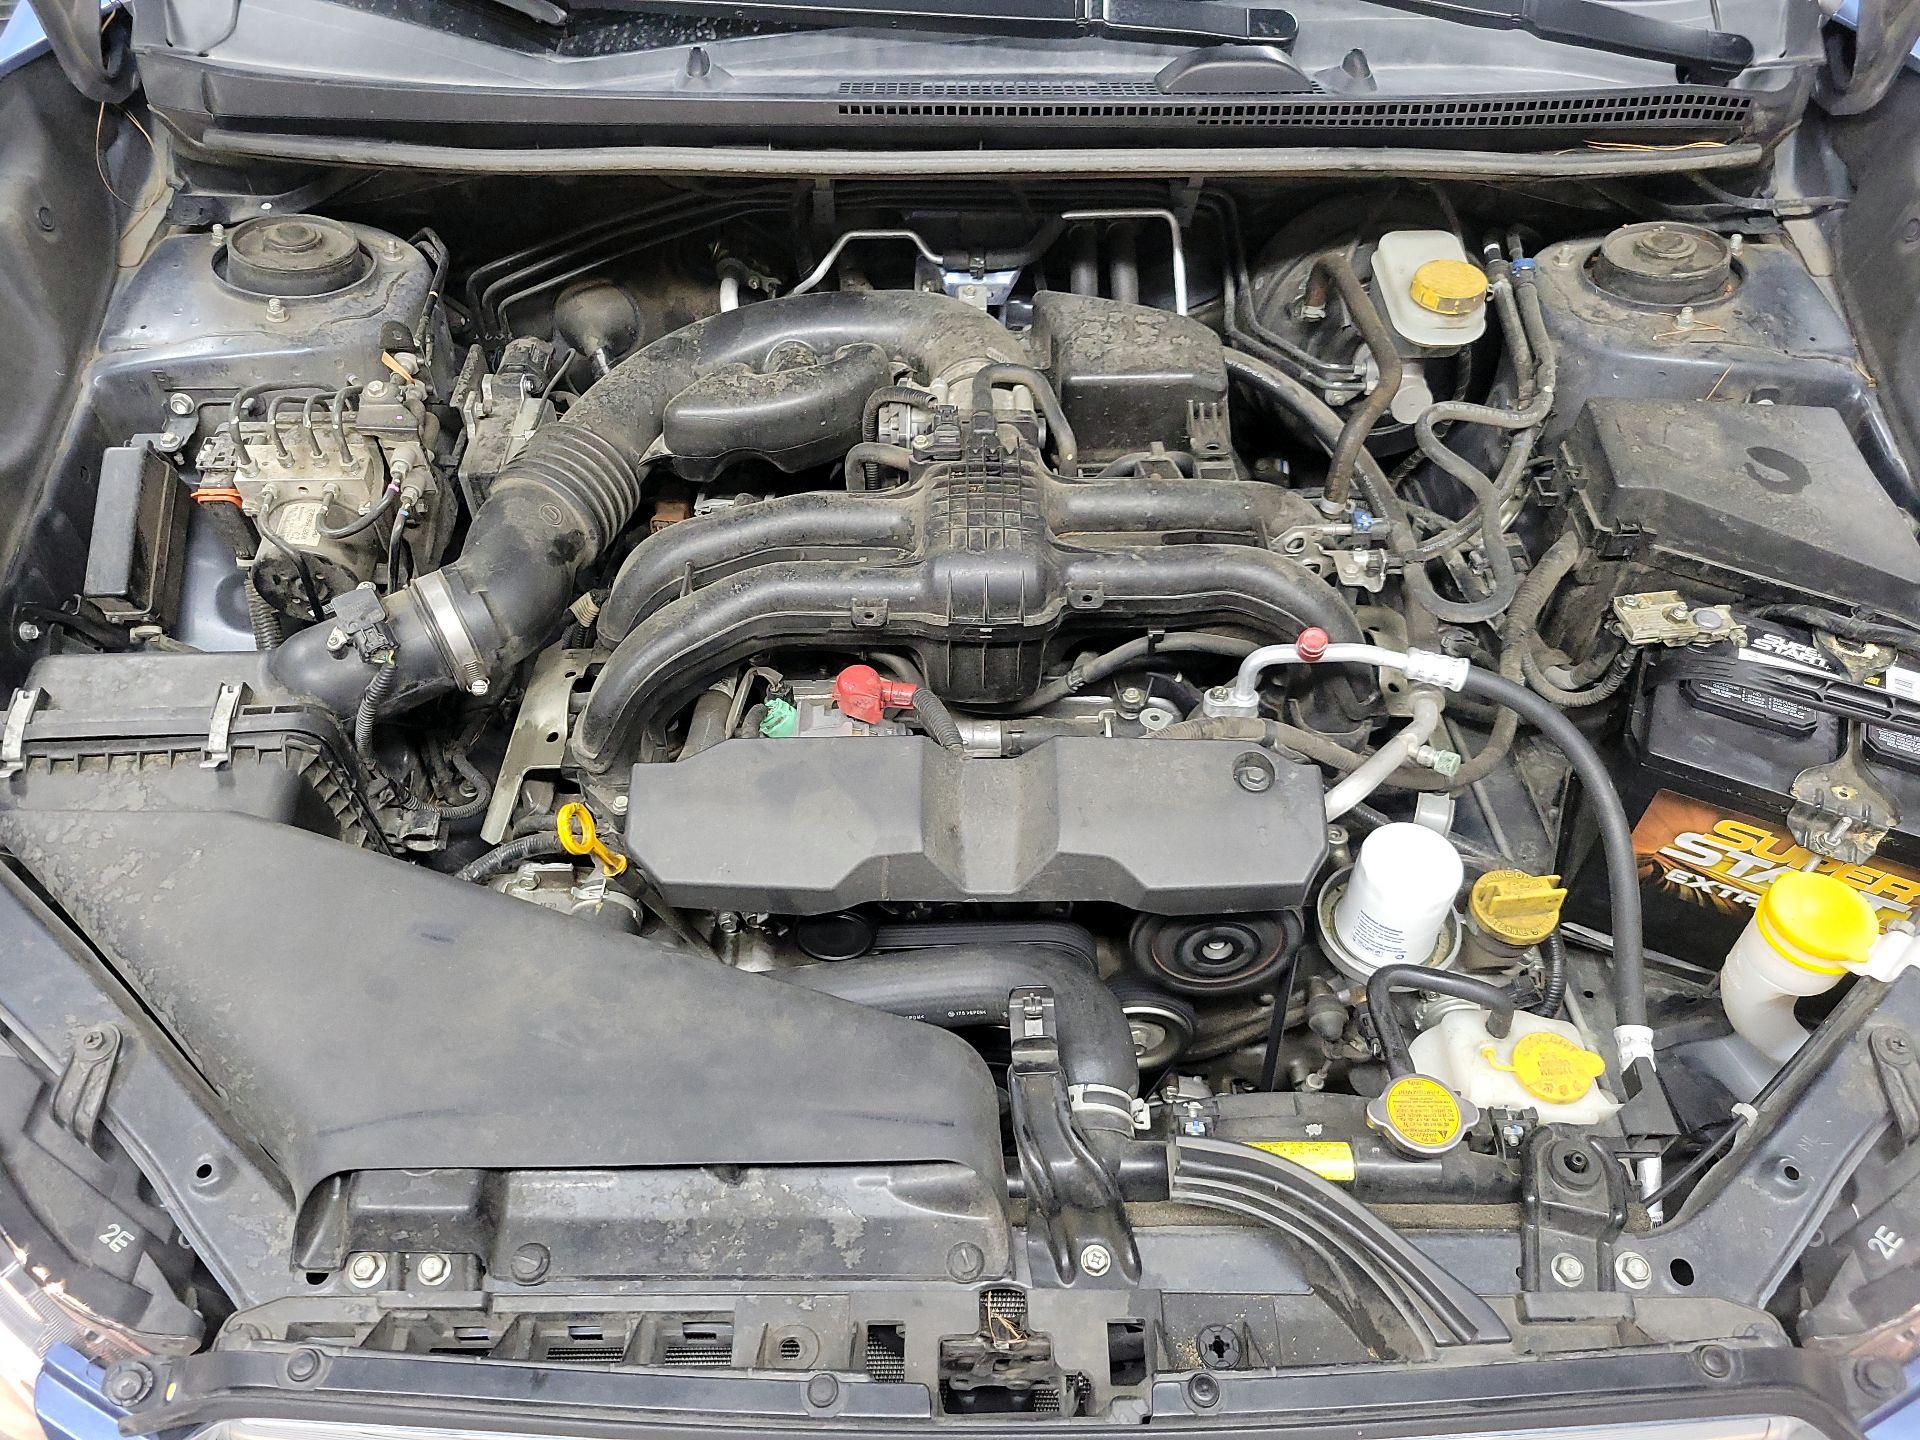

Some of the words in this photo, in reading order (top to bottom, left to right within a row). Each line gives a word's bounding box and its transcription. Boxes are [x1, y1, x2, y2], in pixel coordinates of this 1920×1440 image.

[1665, 868, 1761, 908] EXTR
[98, 1223, 136, 1253] 2E
[1867, 1225, 1904, 1260] 2E
